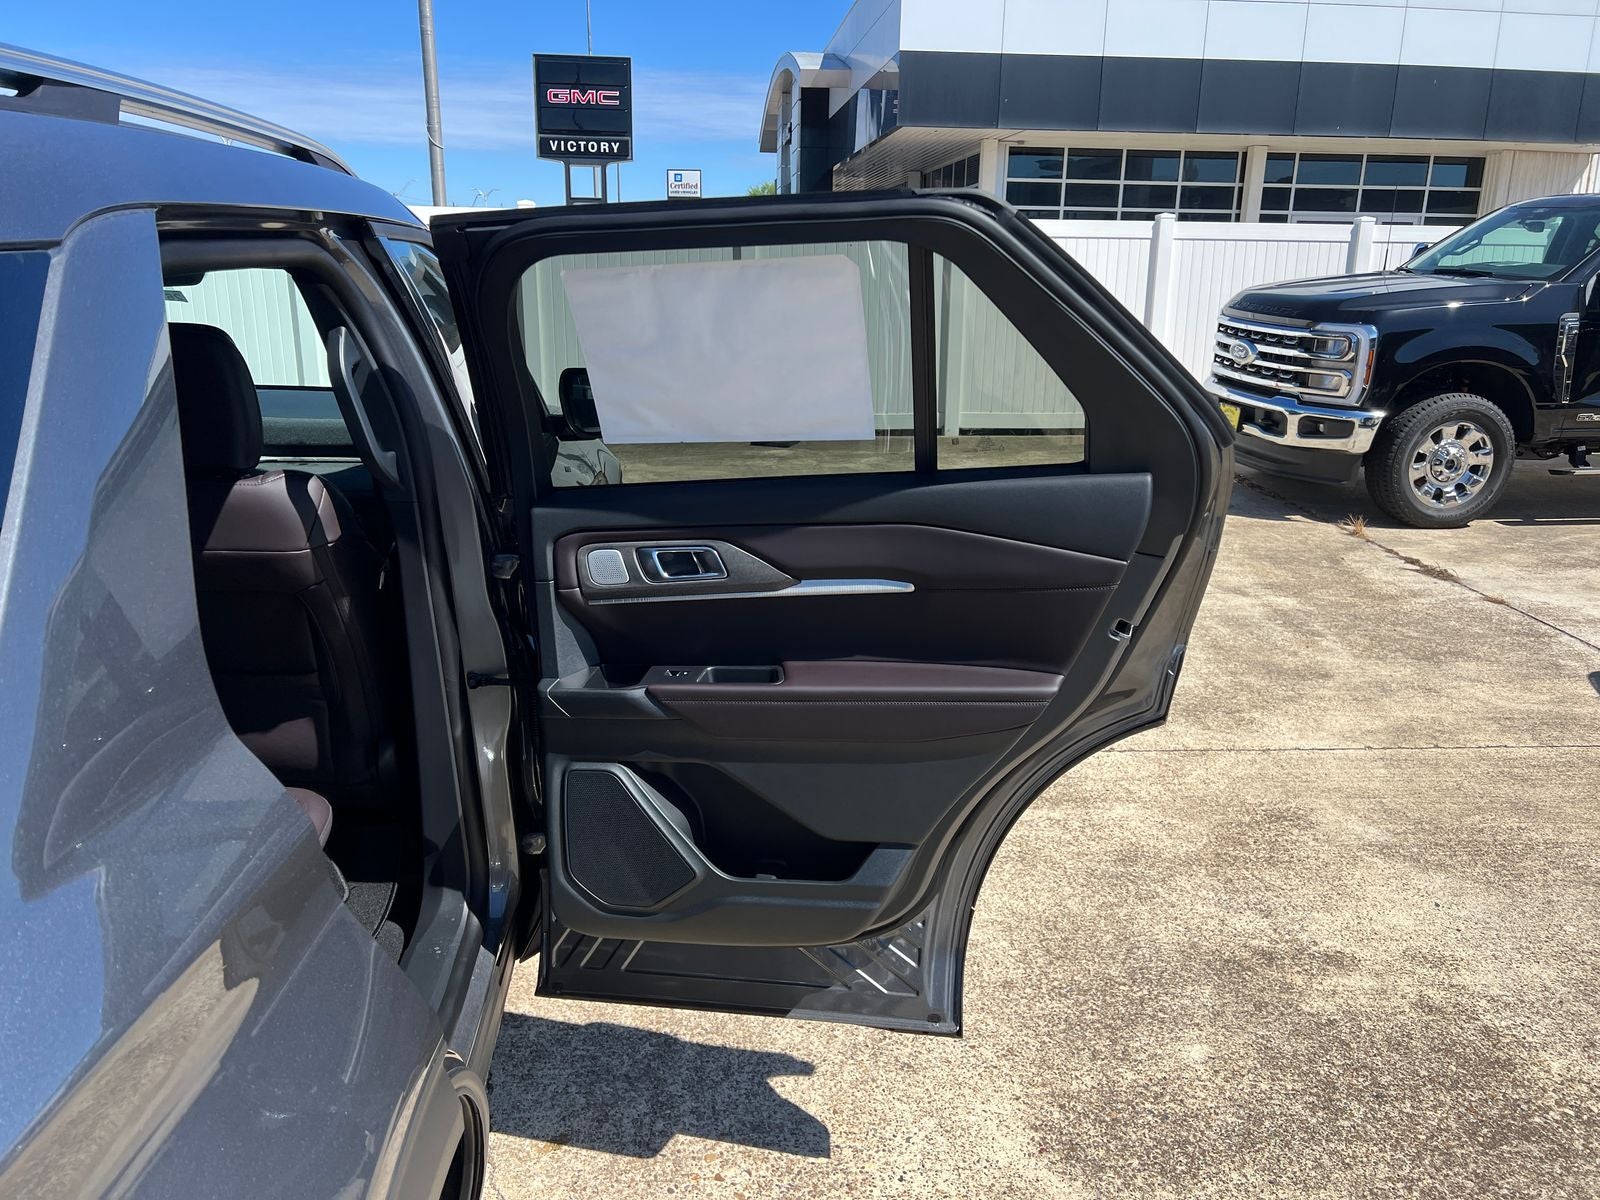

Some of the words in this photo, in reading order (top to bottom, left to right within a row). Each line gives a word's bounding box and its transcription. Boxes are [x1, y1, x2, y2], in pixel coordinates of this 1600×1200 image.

[547, 88, 620, 106] GMC
[549, 140, 620, 153] VICTORY
[669, 182, 699, 190] Certified
